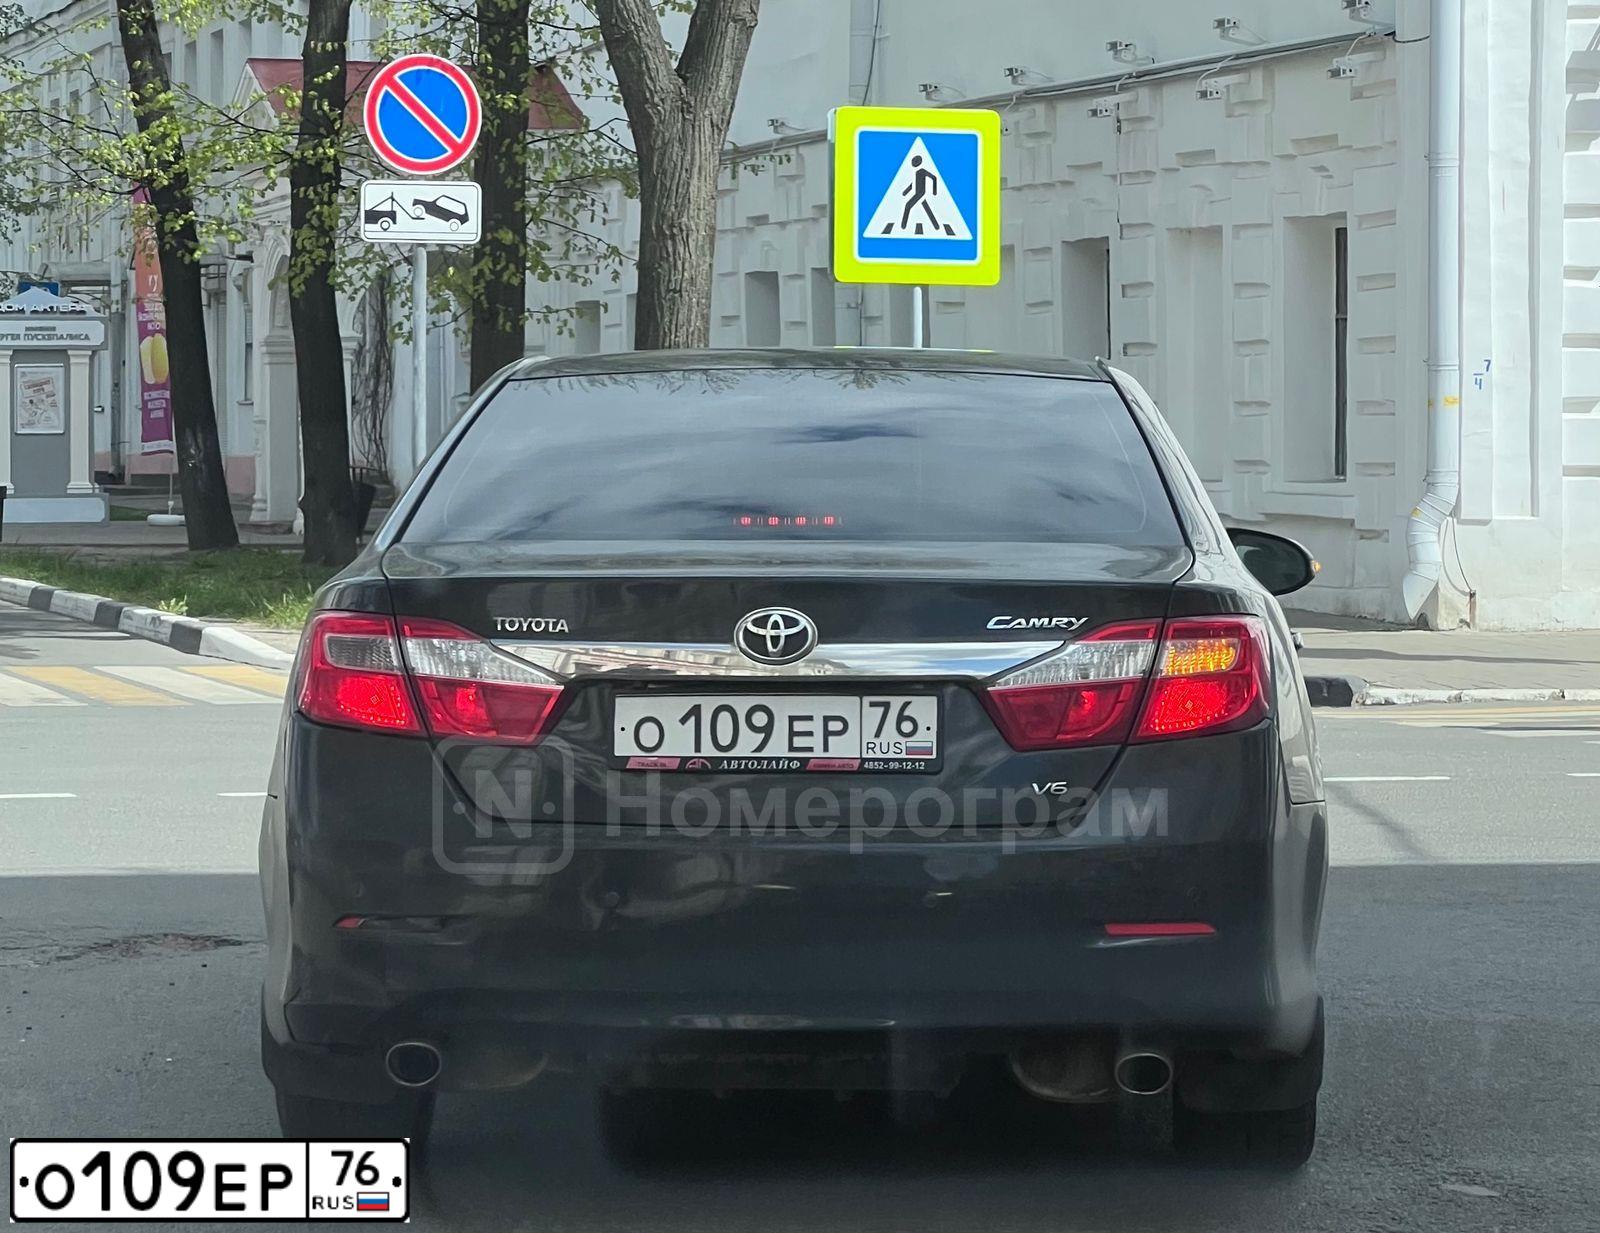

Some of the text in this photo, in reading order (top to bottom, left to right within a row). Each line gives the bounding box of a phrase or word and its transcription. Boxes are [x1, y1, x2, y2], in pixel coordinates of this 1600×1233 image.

[1484, 359, 1491, 372] 7
[493, 617, 569, 633] TOYOTA
[986, 616, 1088, 631] CAMRY
[869, 701, 919, 738] 76
[866, 741, 903, 755] RUS
[719, 757, 801, 770] АВТОЛАЙФ
[864, 761, 925, 770] 4852-99-12-12
[1032, 781, 1067, 795] V6
